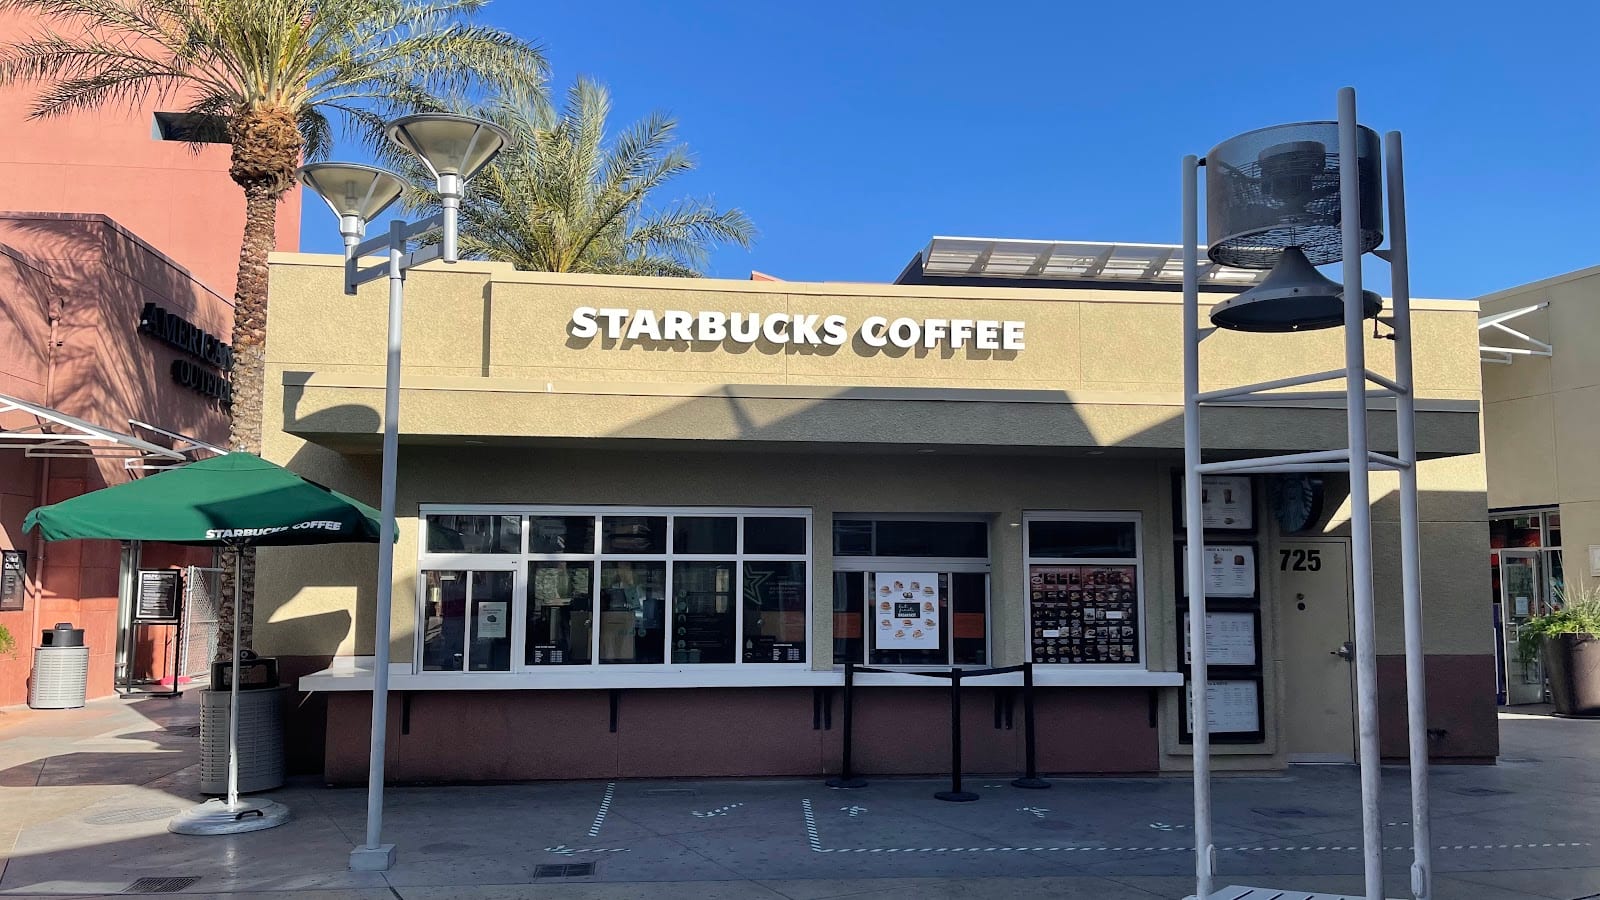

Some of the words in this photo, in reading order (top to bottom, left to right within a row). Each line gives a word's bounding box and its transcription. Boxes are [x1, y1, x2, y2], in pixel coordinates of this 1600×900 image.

[571, 307, 848, 346] STARBUCKS
[861, 317, 1026, 351] COFFEE
[205, 526, 289, 539] STARBUCKS
[292, 520, 342, 531] COFFEE
[1279, 549, 1322, 571] 725
